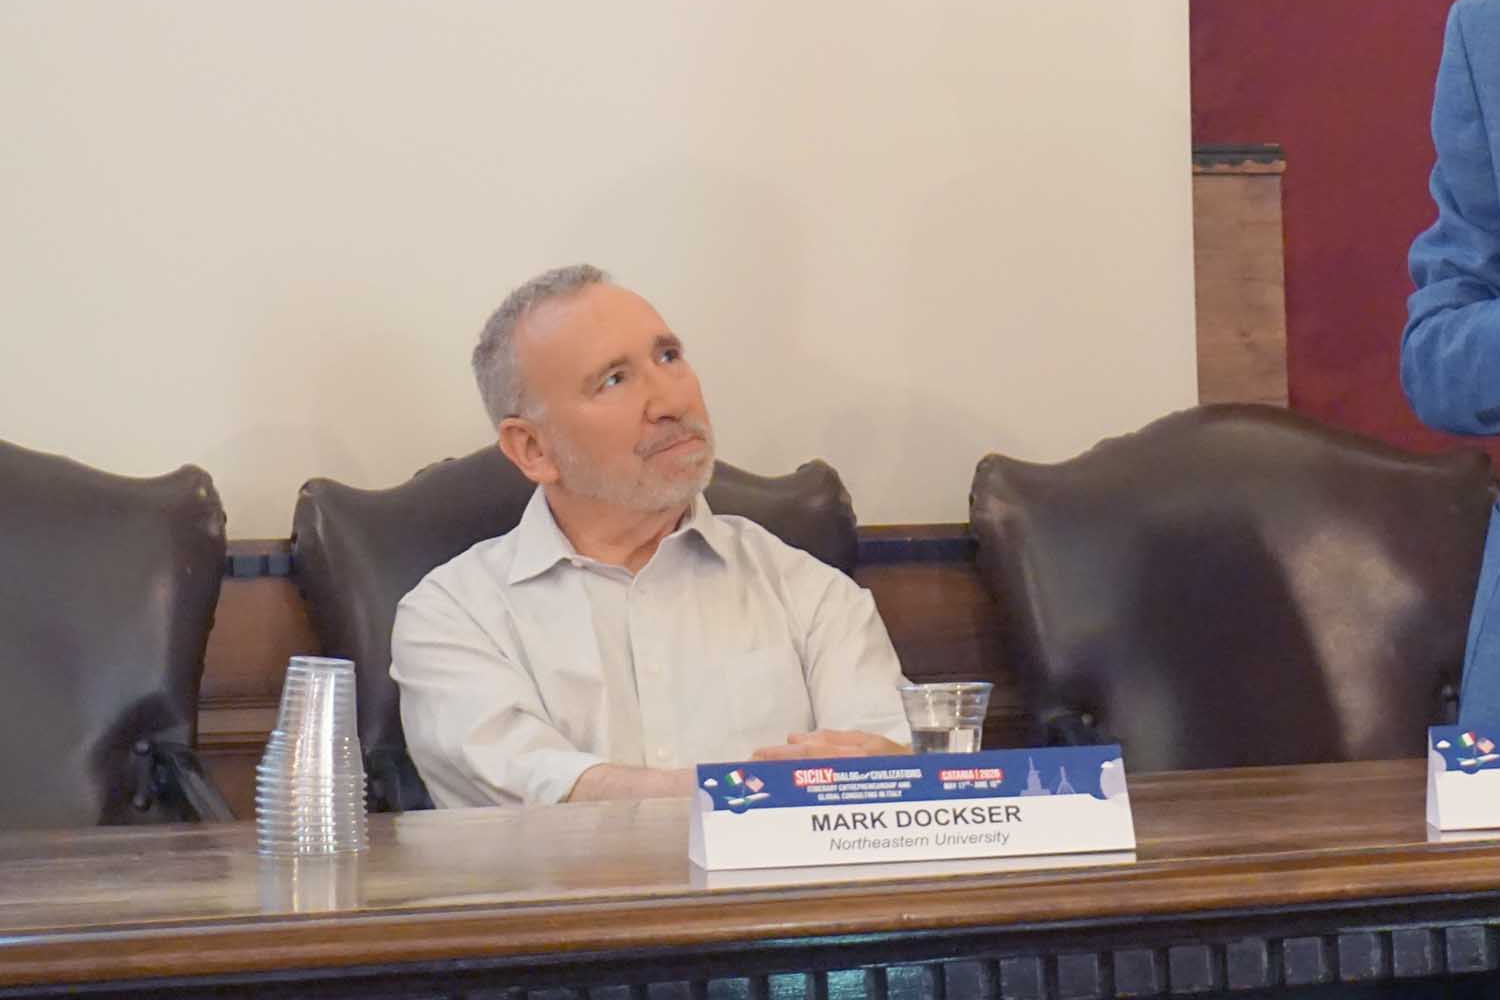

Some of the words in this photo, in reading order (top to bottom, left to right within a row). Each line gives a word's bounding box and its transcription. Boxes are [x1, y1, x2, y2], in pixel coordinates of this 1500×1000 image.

[794, 768, 833, 785] SICILY
[810, 809, 889, 832] MARK
[895, 804, 1023, 830] DOCKSER
[829, 833, 930, 852] Northeastern
[934, 830, 1011, 848] University
